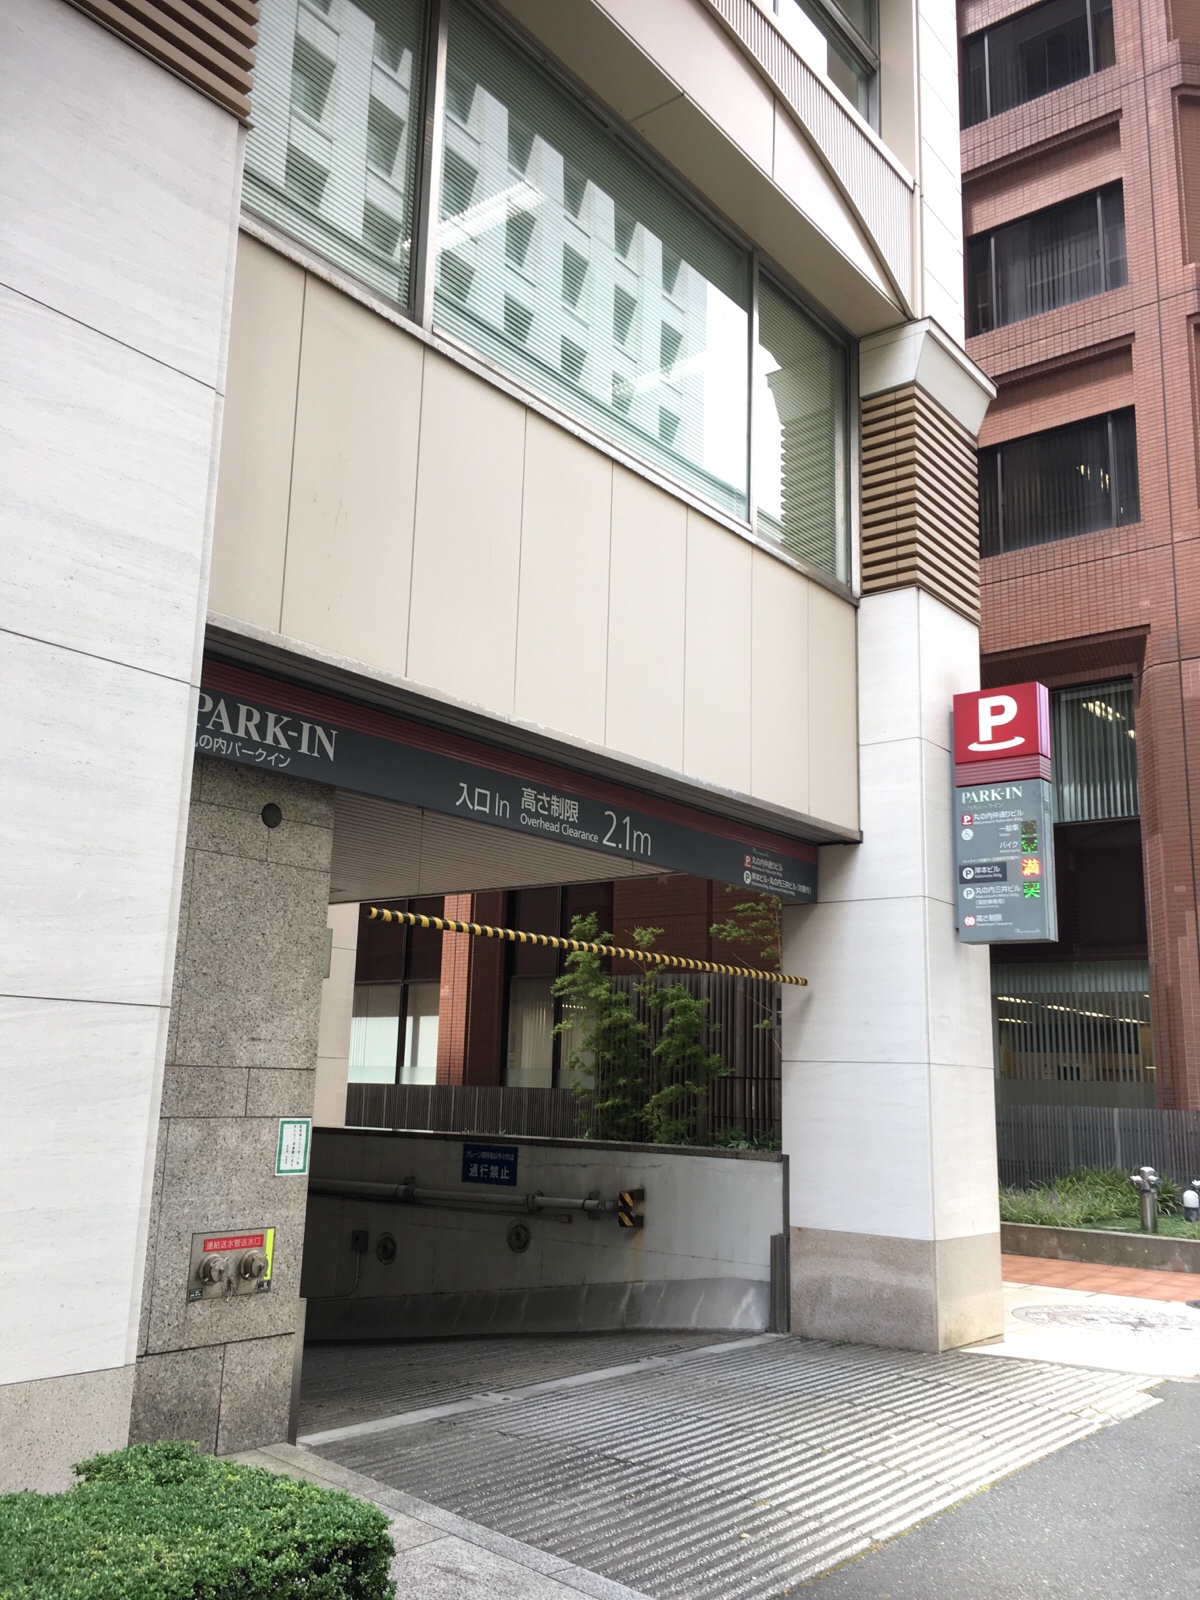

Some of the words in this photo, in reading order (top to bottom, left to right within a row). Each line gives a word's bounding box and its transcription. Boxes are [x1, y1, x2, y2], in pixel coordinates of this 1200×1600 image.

[978, 694, 1018, 742] P
[195, 734, 291, 768] の内パークイン
[455, 782, 490, 814] 入口
[520, 786, 579, 824] 高さ制限
[961, 786, 1023, 804] PARK-IN
[519, 813, 560, 834] Overhead
[561, 824, 599, 844] Clearance
[602, 810, 652, 856] 2.1m
[999, 841, 1019, 849] バイク
[975, 885, 1021, 895] 丸の内三井ビル
[469, 1163, 510, 1179] 通行禁止
